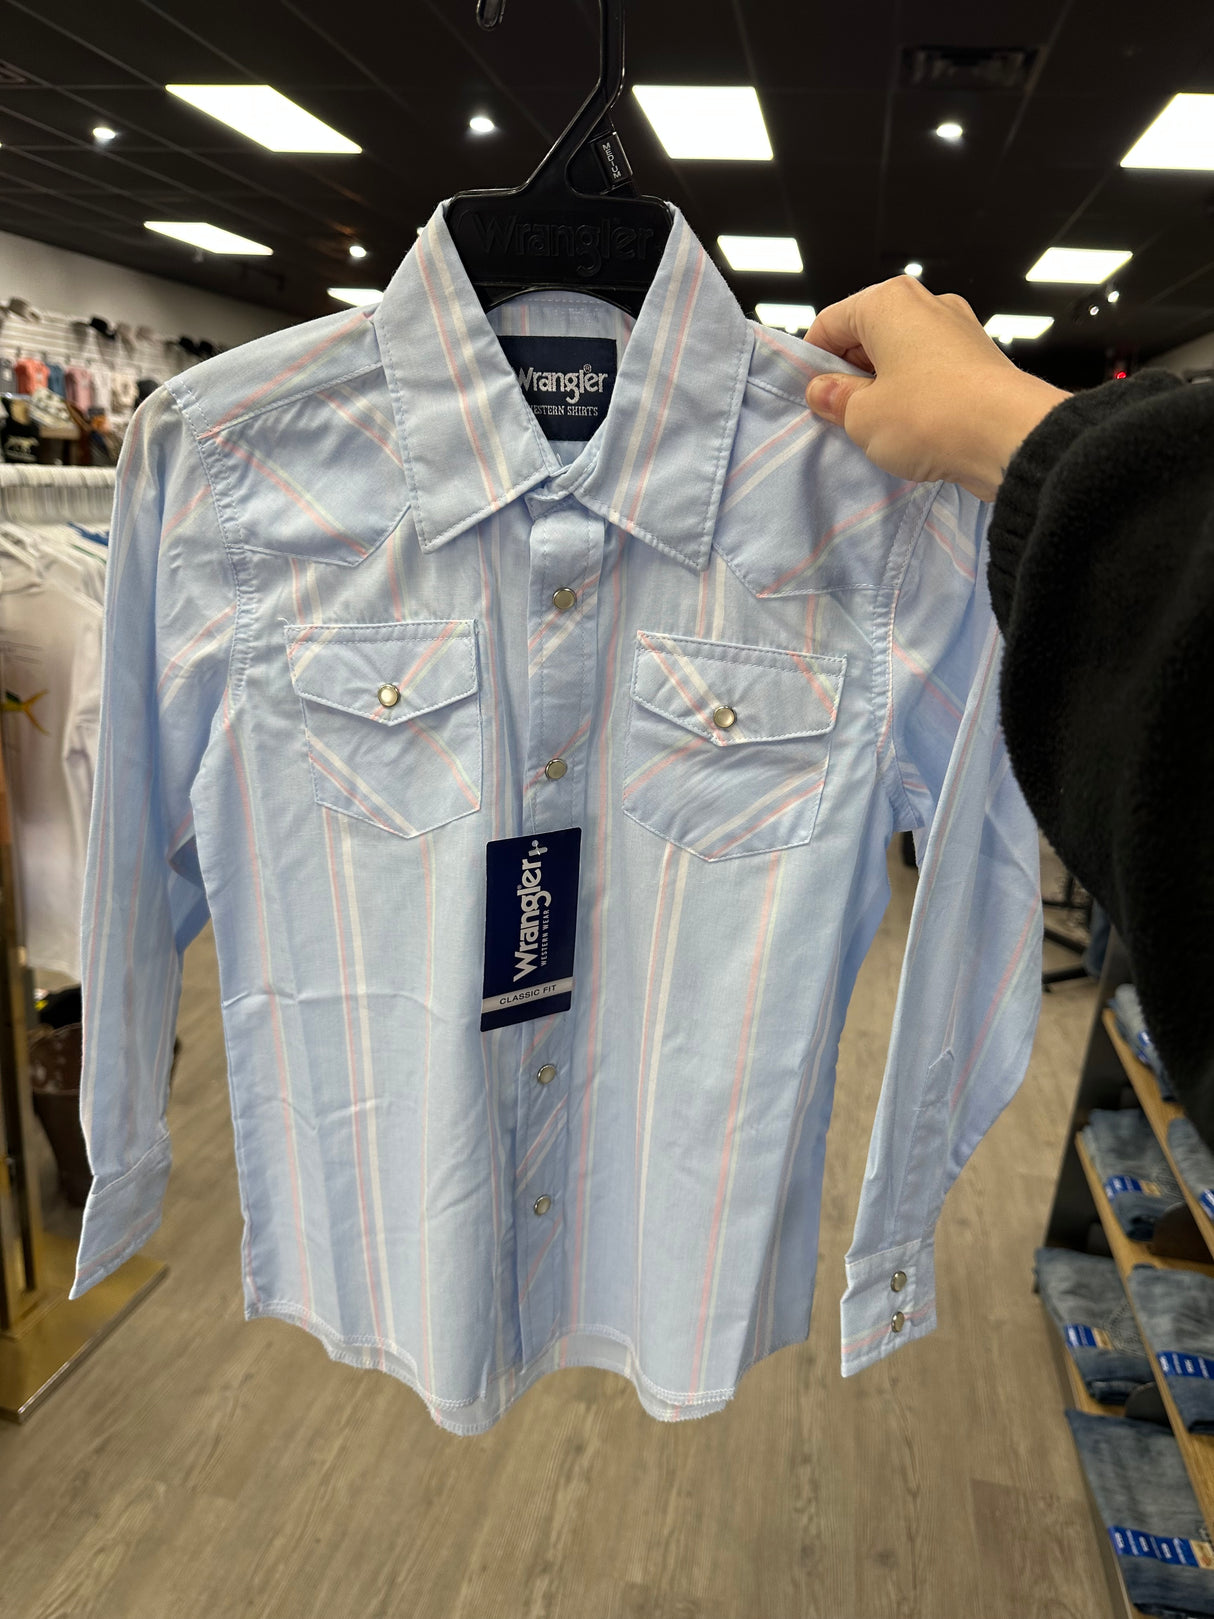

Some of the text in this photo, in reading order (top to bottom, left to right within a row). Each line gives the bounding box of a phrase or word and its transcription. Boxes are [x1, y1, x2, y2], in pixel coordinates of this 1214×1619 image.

[602, 142, 621, 179] MEDIUM
[471, 212, 655, 278] Wrangler
[531, 404, 598, 417] ESTERN SHIRTS
[513, 858, 552, 983] Wrangler
[540, 909, 550, 967] WESTERN WEAR
[499, 984, 557, 1005] CLASSIC FIT
